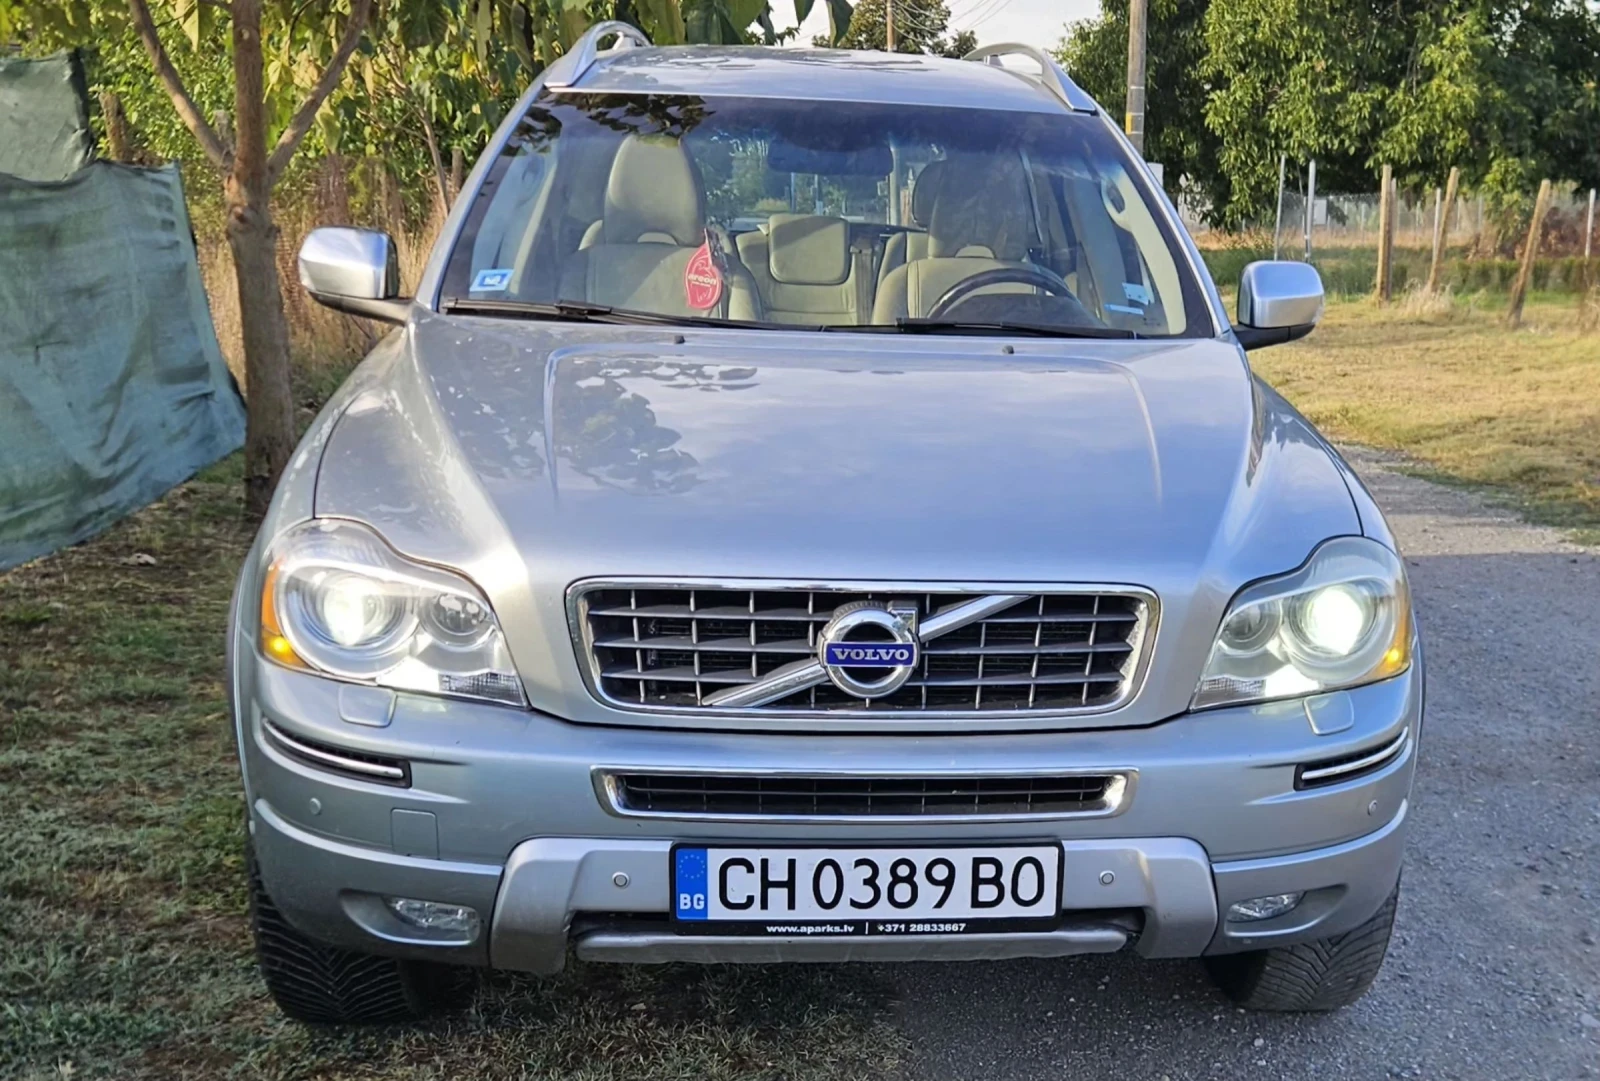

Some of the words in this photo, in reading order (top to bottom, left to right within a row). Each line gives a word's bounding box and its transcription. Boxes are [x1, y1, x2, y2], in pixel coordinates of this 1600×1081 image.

[831, 648, 909, 661] VOLVO
[718, 857, 796, 911] CH
[812, 858, 956, 910] 0389
[970, 856, 1045, 909] BO
[679, 893, 705, 910] BG
[766, 924, 854, 935] www.aparks.lv
[877, 923, 905, 932] +371
[909, 923, 967, 932] 28833667
